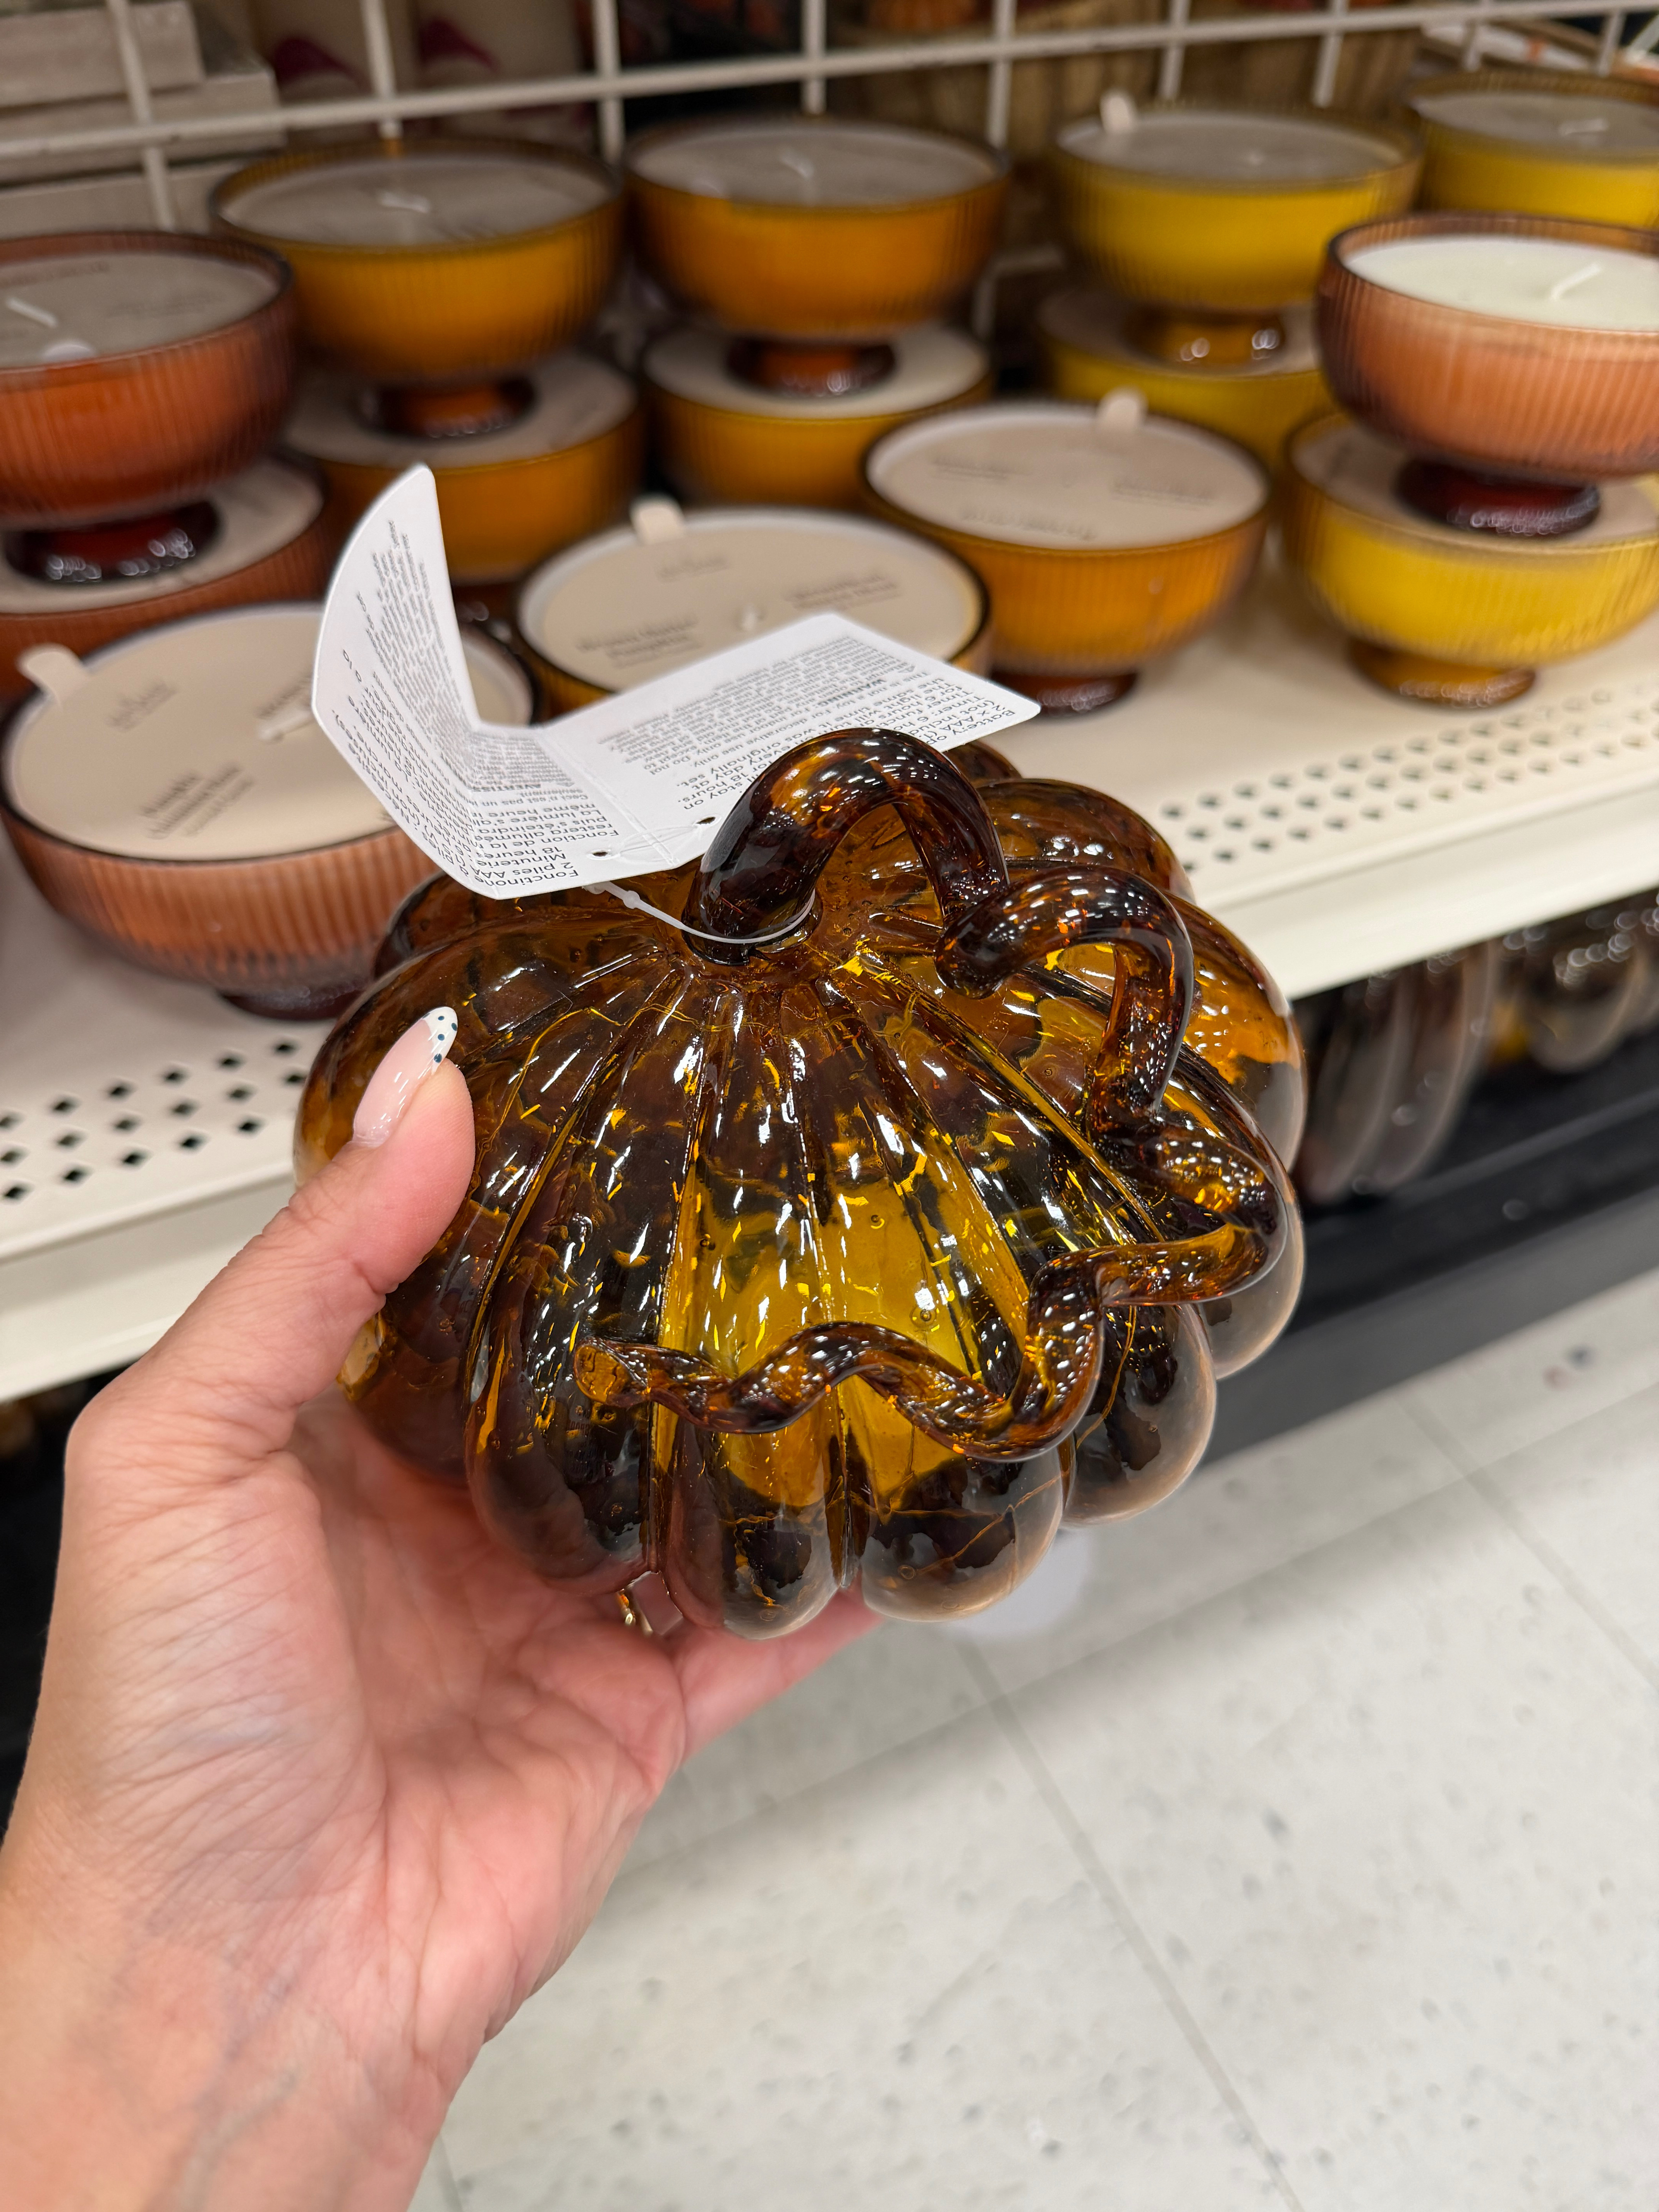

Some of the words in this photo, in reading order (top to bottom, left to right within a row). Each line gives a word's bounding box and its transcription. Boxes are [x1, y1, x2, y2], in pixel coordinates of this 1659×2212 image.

[343, 649, 352, 670] la
[903, 672, 929, 682] This
[917, 678, 945, 689] the
[867, 687, 888, 697] not
[923, 683, 955, 694] The
[940, 686, 962, 696] for
[364, 687, 386, 721] jour
[833, 699, 856, 709] toy.
[873, 689, 914, 706] same
[883, 694, 922, 712] light
[927, 691, 973, 709] Timer
[371, 685, 406, 741] réglée.
[878, 701, 923, 721] hours
[931, 696, 984, 716] Timer:
[960, 700, 995, 715] (not
[811, 709, 831, 719] For
[835, 707, 871, 722] time
[854, 710, 881, 722] will
[876, 709, 923, 731] functi
[952, 707, 1015, 735] Battery
[348, 696, 391, 761] lumière
[362, 694, 402, 756] heures.
[908, 714, 960, 737] includ
[939, 716, 974, 731] AAA
[746, 718, 808, 745] decorative
[785, 728, 816, 741] was
[919, 731, 938, 740] (1.
[332, 710, 388, 789] incluses).
[387, 721, 428, 778] chaque
[721, 744, 744, 755] use
[749, 745, 793, 766] every
[404, 756, 417, 776] 18
[672, 755, 691, 765] Do
[694, 754, 719, 768] only.
[711, 742, 781, 775] originally
[394, 760, 409, 783] La
[404, 764, 412, 777] 6
[649, 764, 670, 775] not
[716, 766, 744, 780] day
[348, 743, 410, 824] Nécessite
[677, 774, 706, 787] set.
[692, 780, 710, 790] at
[730, 773, 749, 782] 18
[747, 774, 762, 783] ll
[678, 781, 728, 802] hours.
[710, 782, 743, 799] stay
[392, 788, 419, 826] (non
[414, 777, 469, 836] pendant
[419, 775, 474, 832] pendant
[543, 804, 596, 812] même
[684, 799, 704, 809] on
[406, 795, 451, 846] heures
[419, 791, 484, 849] minuterie
[488, 809, 539, 817] heure
[510, 812, 576, 823] lumière
[478, 822, 567, 835] s'éteindra
[572, 816, 607, 826] puis
[424, 825, 438, 845] V)
[433, 816, 471, 852] arrêt.
[474, 832, 544, 842] allumée
[541, 830, 619, 843] Fonction
[550, 824, 613, 835] restera
[422, 831, 454, 865] piles
[441, 843, 465, 867] (1.5
[454, 845, 464, 856] 6
[476, 849, 537, 859] heures
[477, 853, 566, 868] Minuterie
[459, 864, 469, 877] à
[470, 865, 505, 879] AAA
[512, 863, 555, 875] piles
[474, 870, 579, 886] Fonctinone
